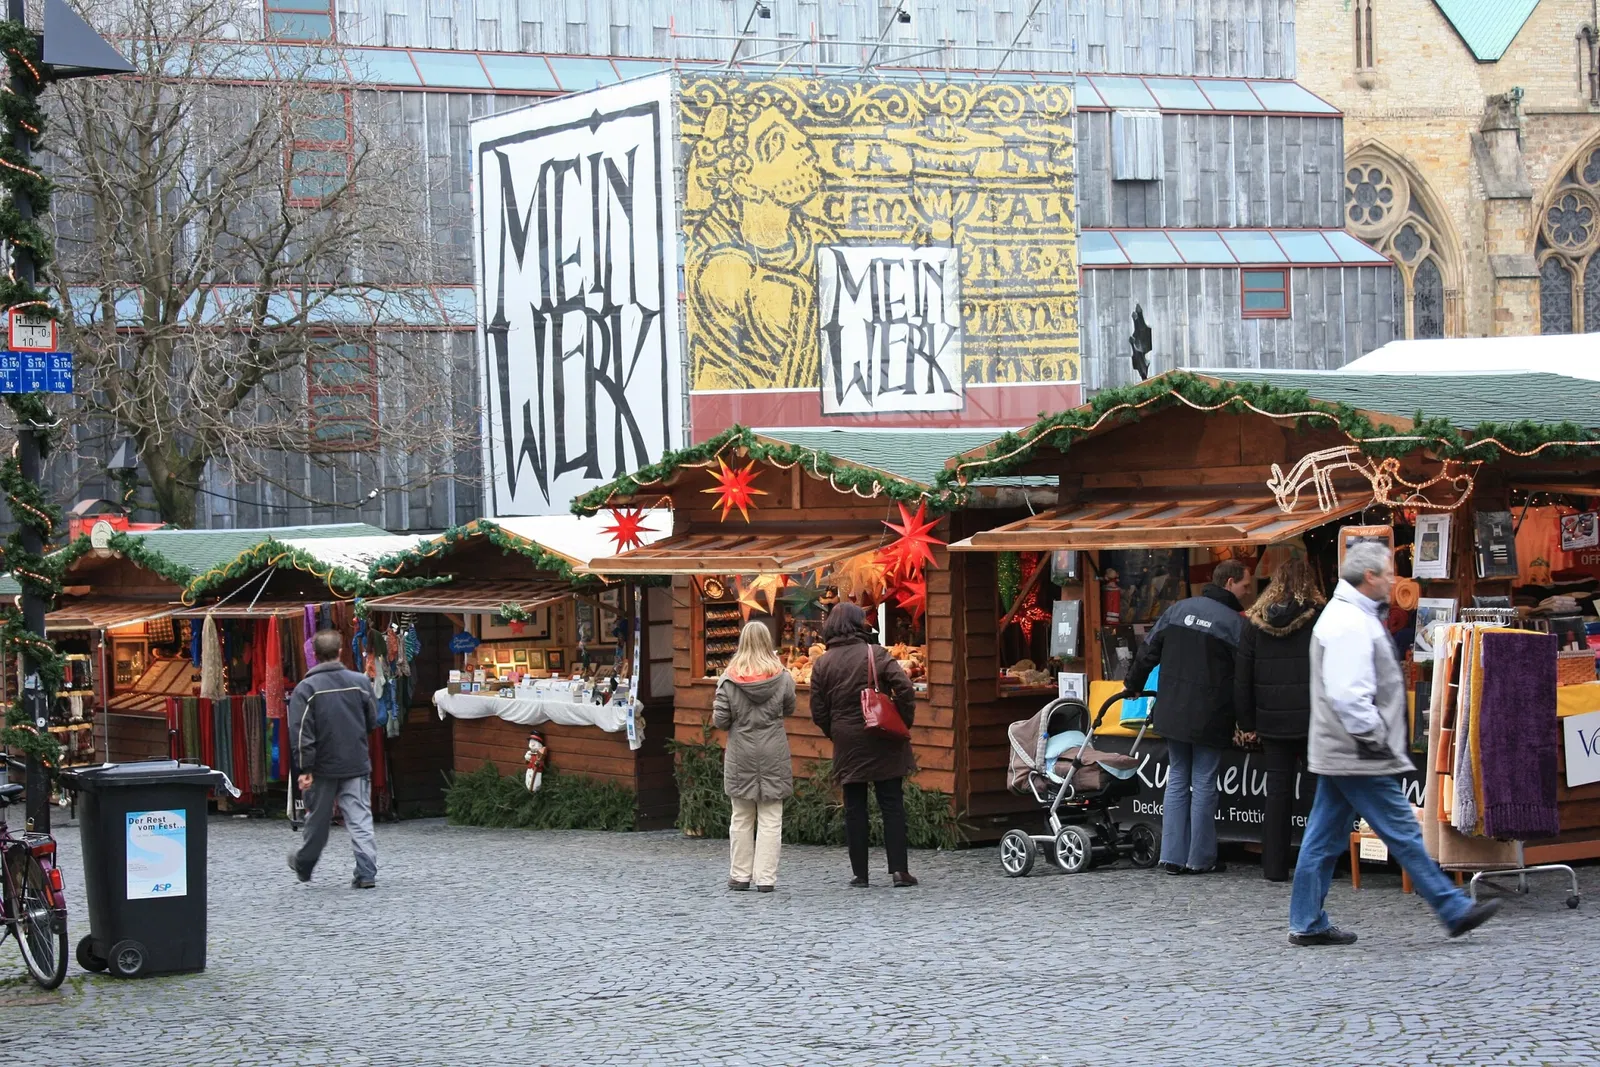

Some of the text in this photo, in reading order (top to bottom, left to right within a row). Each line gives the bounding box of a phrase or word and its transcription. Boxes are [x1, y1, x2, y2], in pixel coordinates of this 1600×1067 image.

[490, 144, 645, 314] MEIN
[828, 246, 948, 326] MEIN
[486, 301, 661, 507] WERK
[821, 317, 962, 408] WERK
[128, 816, 167, 825] Der Rest
[151, 883, 172, 892] ASP
